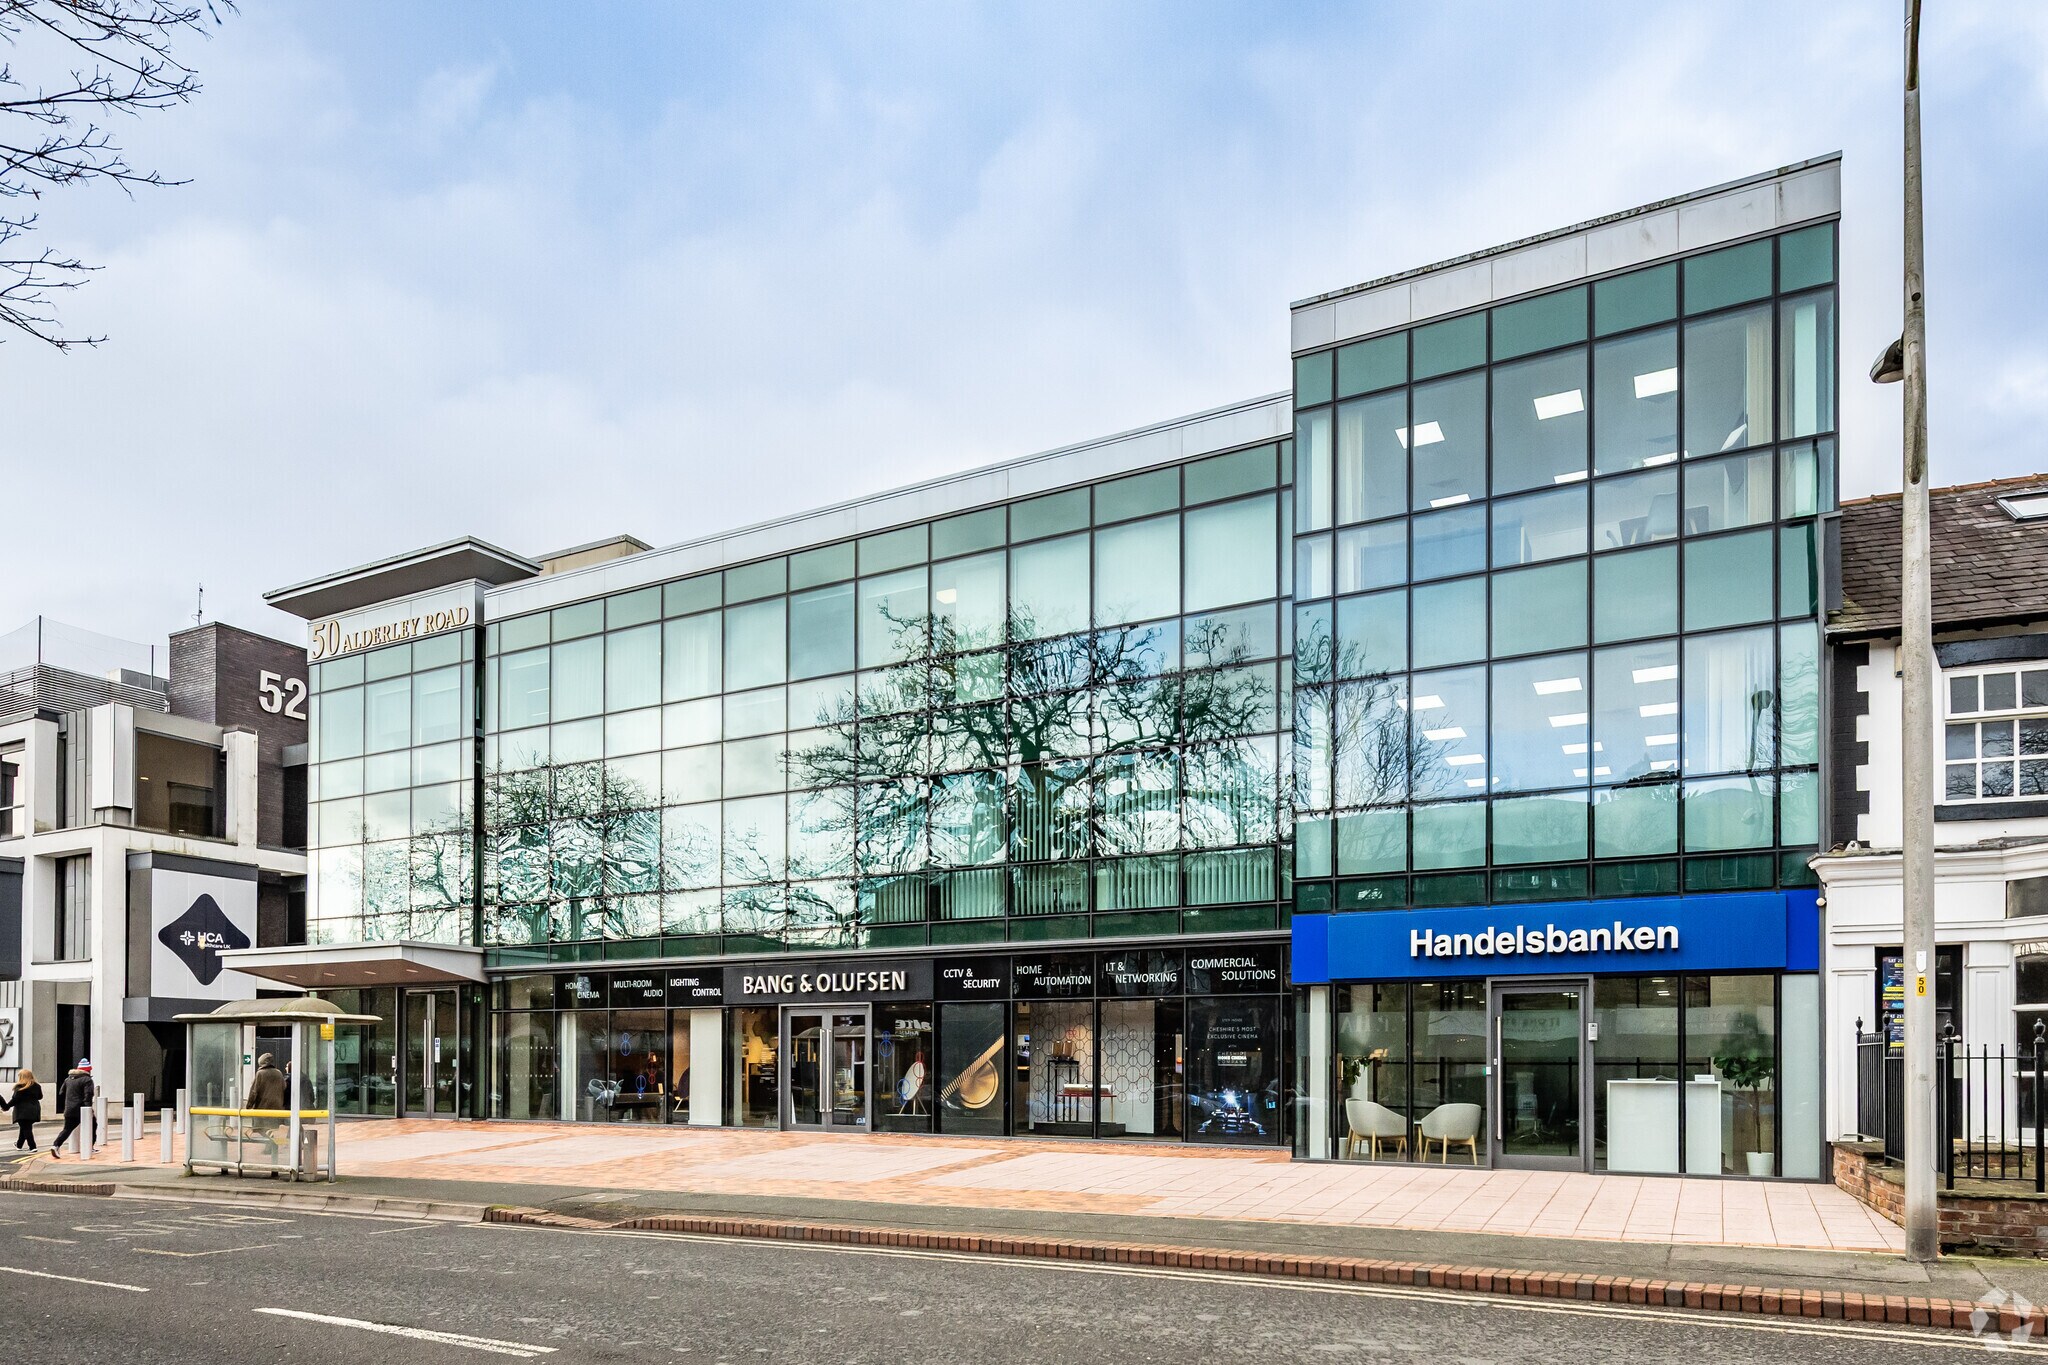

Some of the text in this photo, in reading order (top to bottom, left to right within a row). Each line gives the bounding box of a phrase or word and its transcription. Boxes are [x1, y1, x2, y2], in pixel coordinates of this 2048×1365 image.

[311, 606, 469, 660] 50 ALDERLEY ROAD
[258, 669, 307, 721] 52
[197, 931, 224, 944] HCA
[1410, 921, 1679, 957] Handelsbanken
[1117, 961, 1125, 971] &
[1191, 957, 1257, 969] COMMERCIAL
[943, 968, 973, 978] CCTV &
[1016, 965, 1042, 975] HOME
[1115, 973, 1177, 984] NETWORKING
[1221, 970, 1276, 981] SOLUTIONS
[565, 982, 582, 990] HOME
[613, 979, 652, 989] MULTI-ROOM
[670, 978, 699, 987] LIGHTING
[743, 971, 905, 994] BANG & OLUFSEN
[963, 979, 1000, 989] SECURITY
[1033, 976, 1091, 986] AUTOMATION
[577, 990, 600, 999] CINEMA
[643, 988, 663, 998] AUDIO
[692, 988, 722, 997] CONTROL
